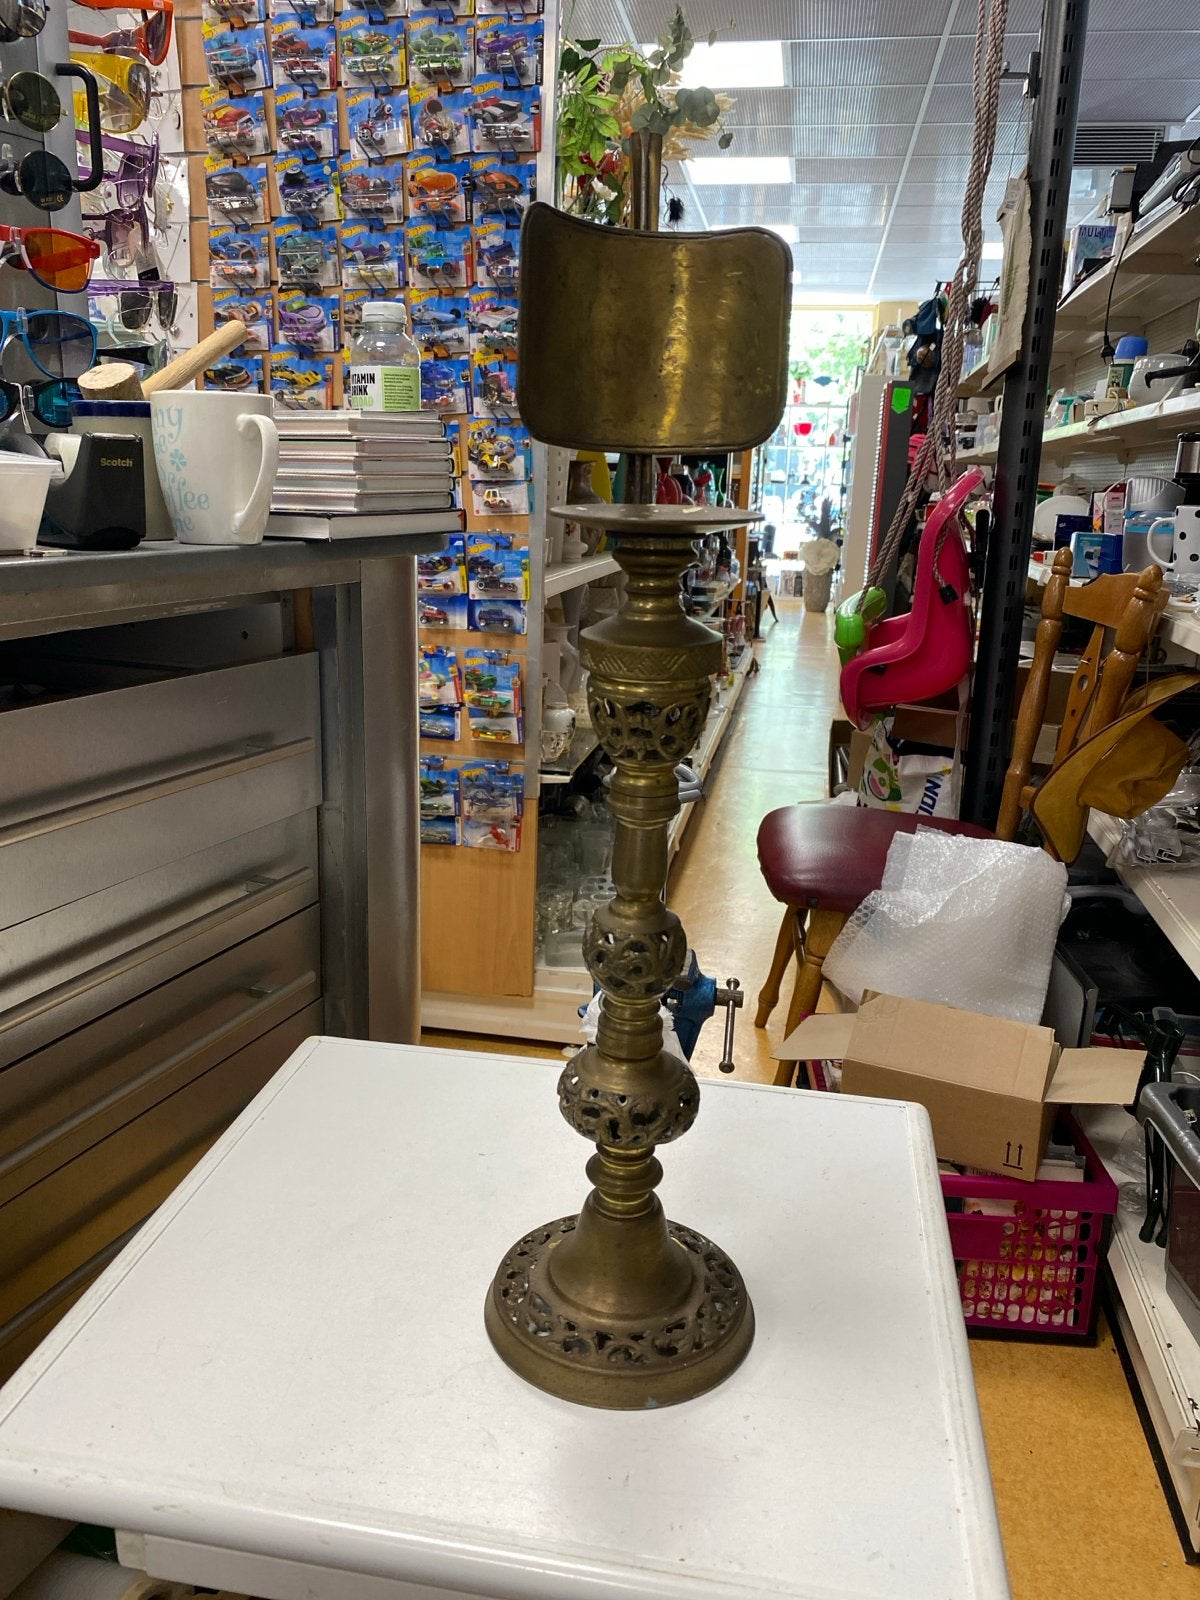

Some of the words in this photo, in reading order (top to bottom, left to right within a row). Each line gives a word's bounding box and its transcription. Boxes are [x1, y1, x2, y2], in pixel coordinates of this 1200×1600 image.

[352, 373, 376, 385] ITAMIN
[100, 457, 133, 467] Scotch
[916, 778, 942, 816] ION
